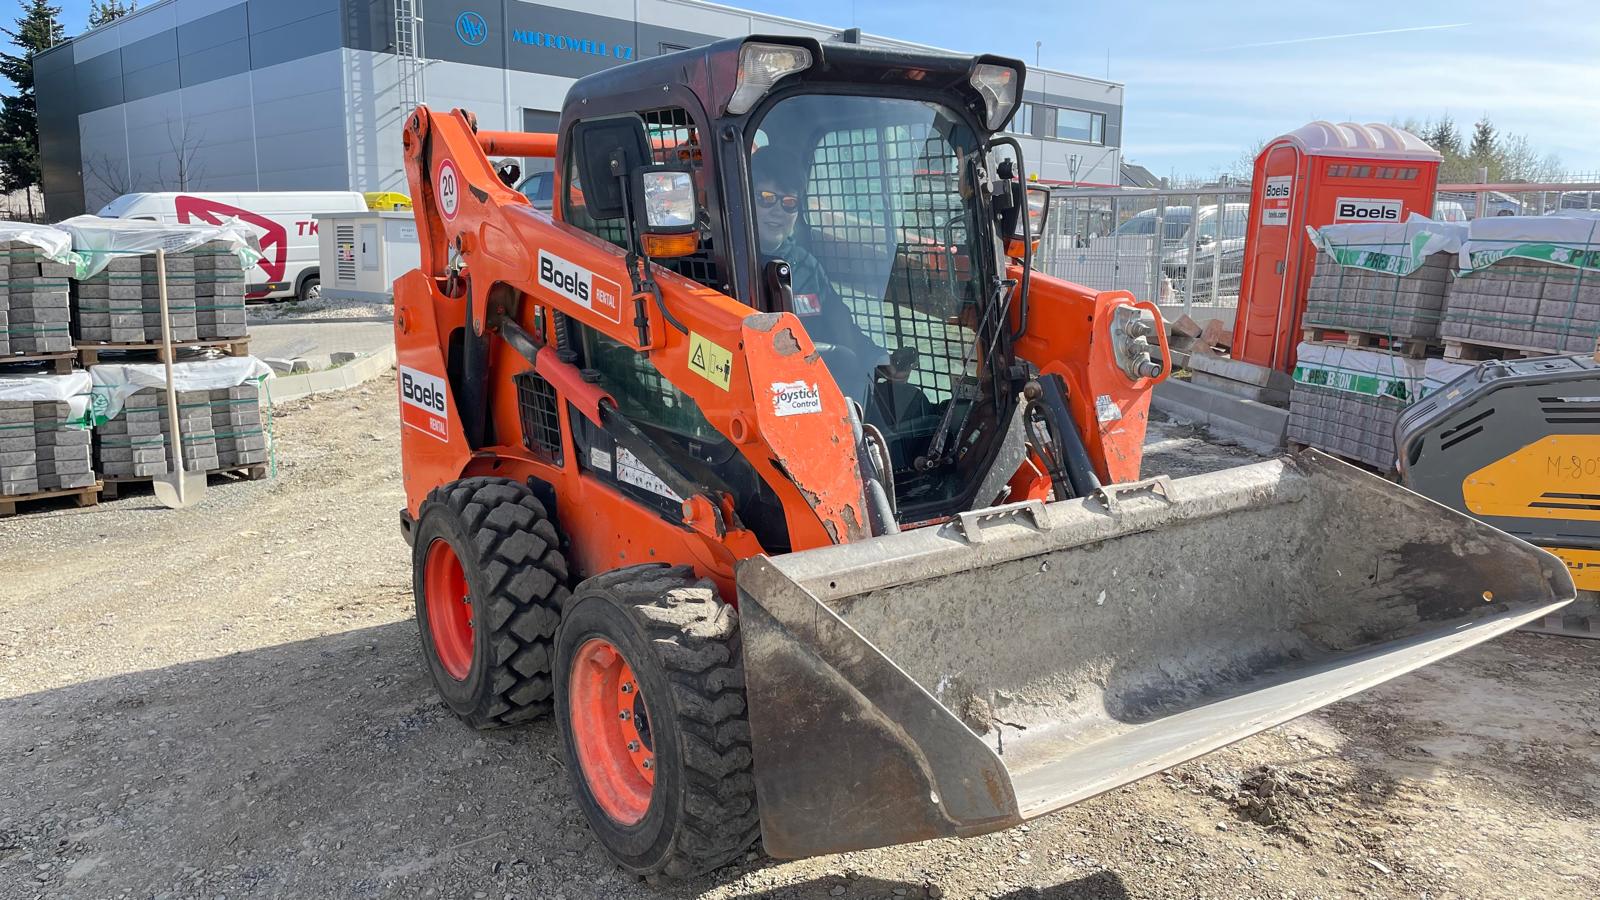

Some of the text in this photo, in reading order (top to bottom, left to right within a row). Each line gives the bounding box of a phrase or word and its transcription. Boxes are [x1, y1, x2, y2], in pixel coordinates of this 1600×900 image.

[512, 29, 633, 60] MICROWELL CZ
[442, 174, 454, 196] 20
[1266, 184, 1289, 197] Boels
[1339, 203, 1397, 219] Boels
[541, 256, 589, 301] Boels
[596, 288, 616, 310] RENTAL
[402, 372, 445, 412] Boels
[791, 399, 819, 408] Control
[429, 416, 447, 436] RENTAL
